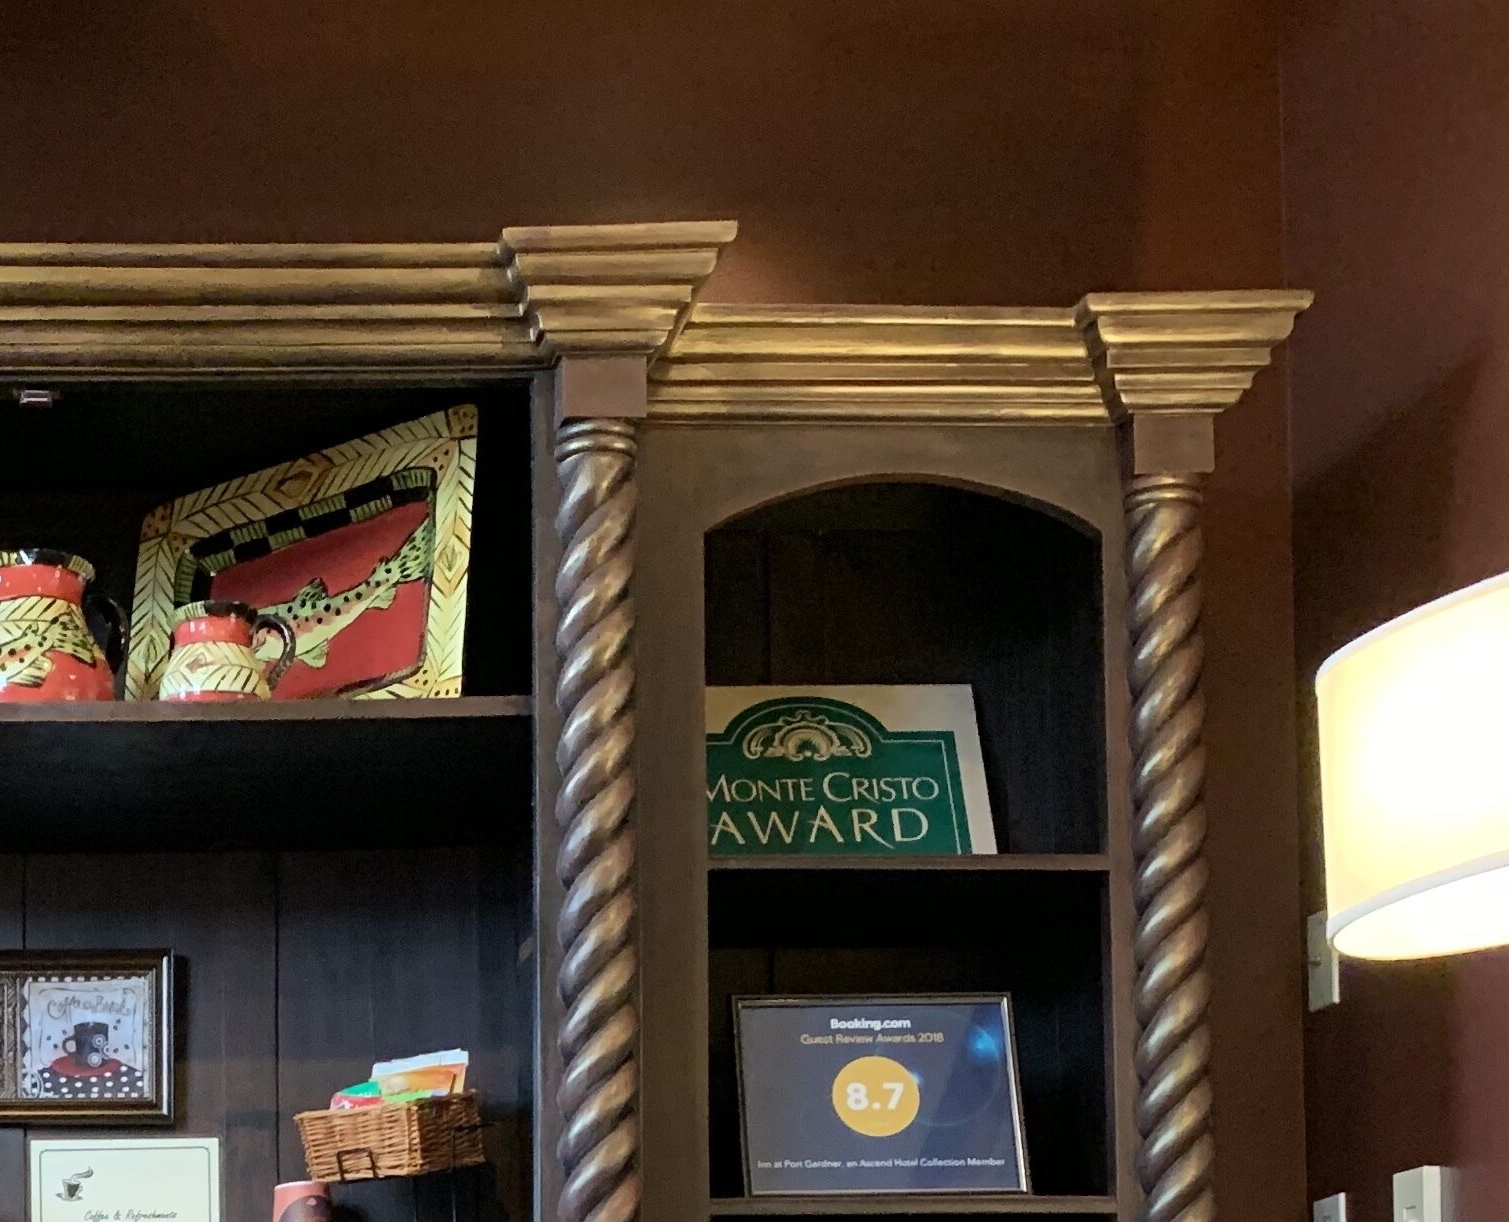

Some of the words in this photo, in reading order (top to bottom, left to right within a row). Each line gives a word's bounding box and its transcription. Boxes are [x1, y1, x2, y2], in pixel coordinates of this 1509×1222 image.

[706, 774, 815, 803] MONTE
[823, 772, 940, 804] CRISTO
[710, 804, 929, 849] AWARD
[830, 1018, 911, 1030] Booking.com
[800, 1034, 833, 1044] Guest
[836, 1034, 874, 1044] Review
[875, 1033, 916, 1043] Awards
[918, 1032, 944, 1042] 2018
[846, 1082, 904, 1111] 8.7
[758, 1160, 772, 1168] Inn
[774, 1160, 782, 1168] at
[784, 1160, 803, 1168] Port
[859, 1159, 892, 1168] Ascend
[894, 1158, 919, 1167] Hotel
[920, 1157, 966, 1167] Collection
[967, 1157, 1005, 1166] Member
[84, 1210, 109, 1222] Coffee
[114, 1210, 121, 1220] &
[126, 1209, 178, 1222] Refreshments
